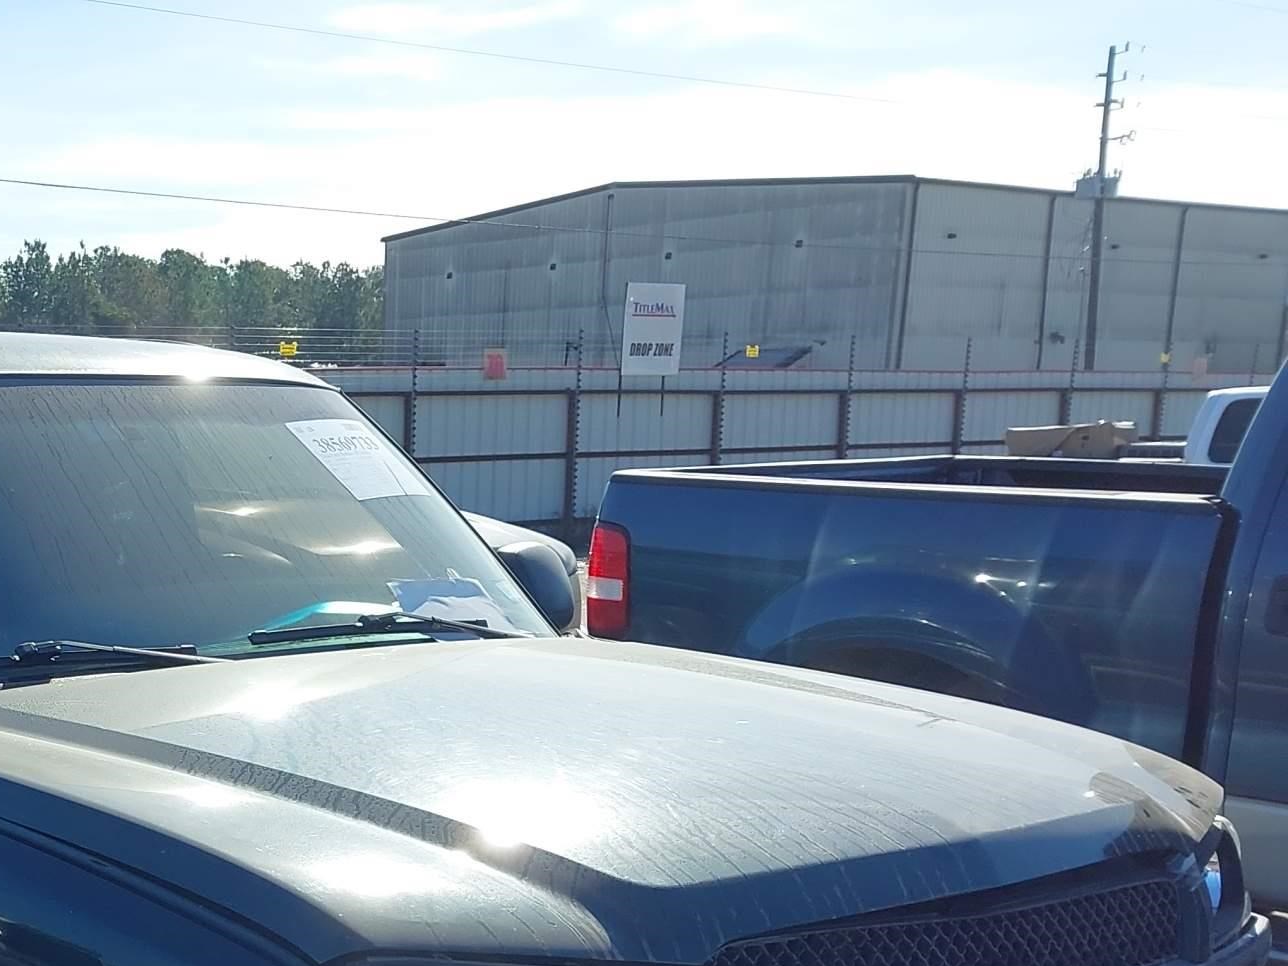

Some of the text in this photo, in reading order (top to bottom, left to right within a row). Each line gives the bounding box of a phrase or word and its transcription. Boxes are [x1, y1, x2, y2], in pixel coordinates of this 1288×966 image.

[630, 343, 674, 356] DROP ZONE
[313, 436, 379, 453] 38569733
